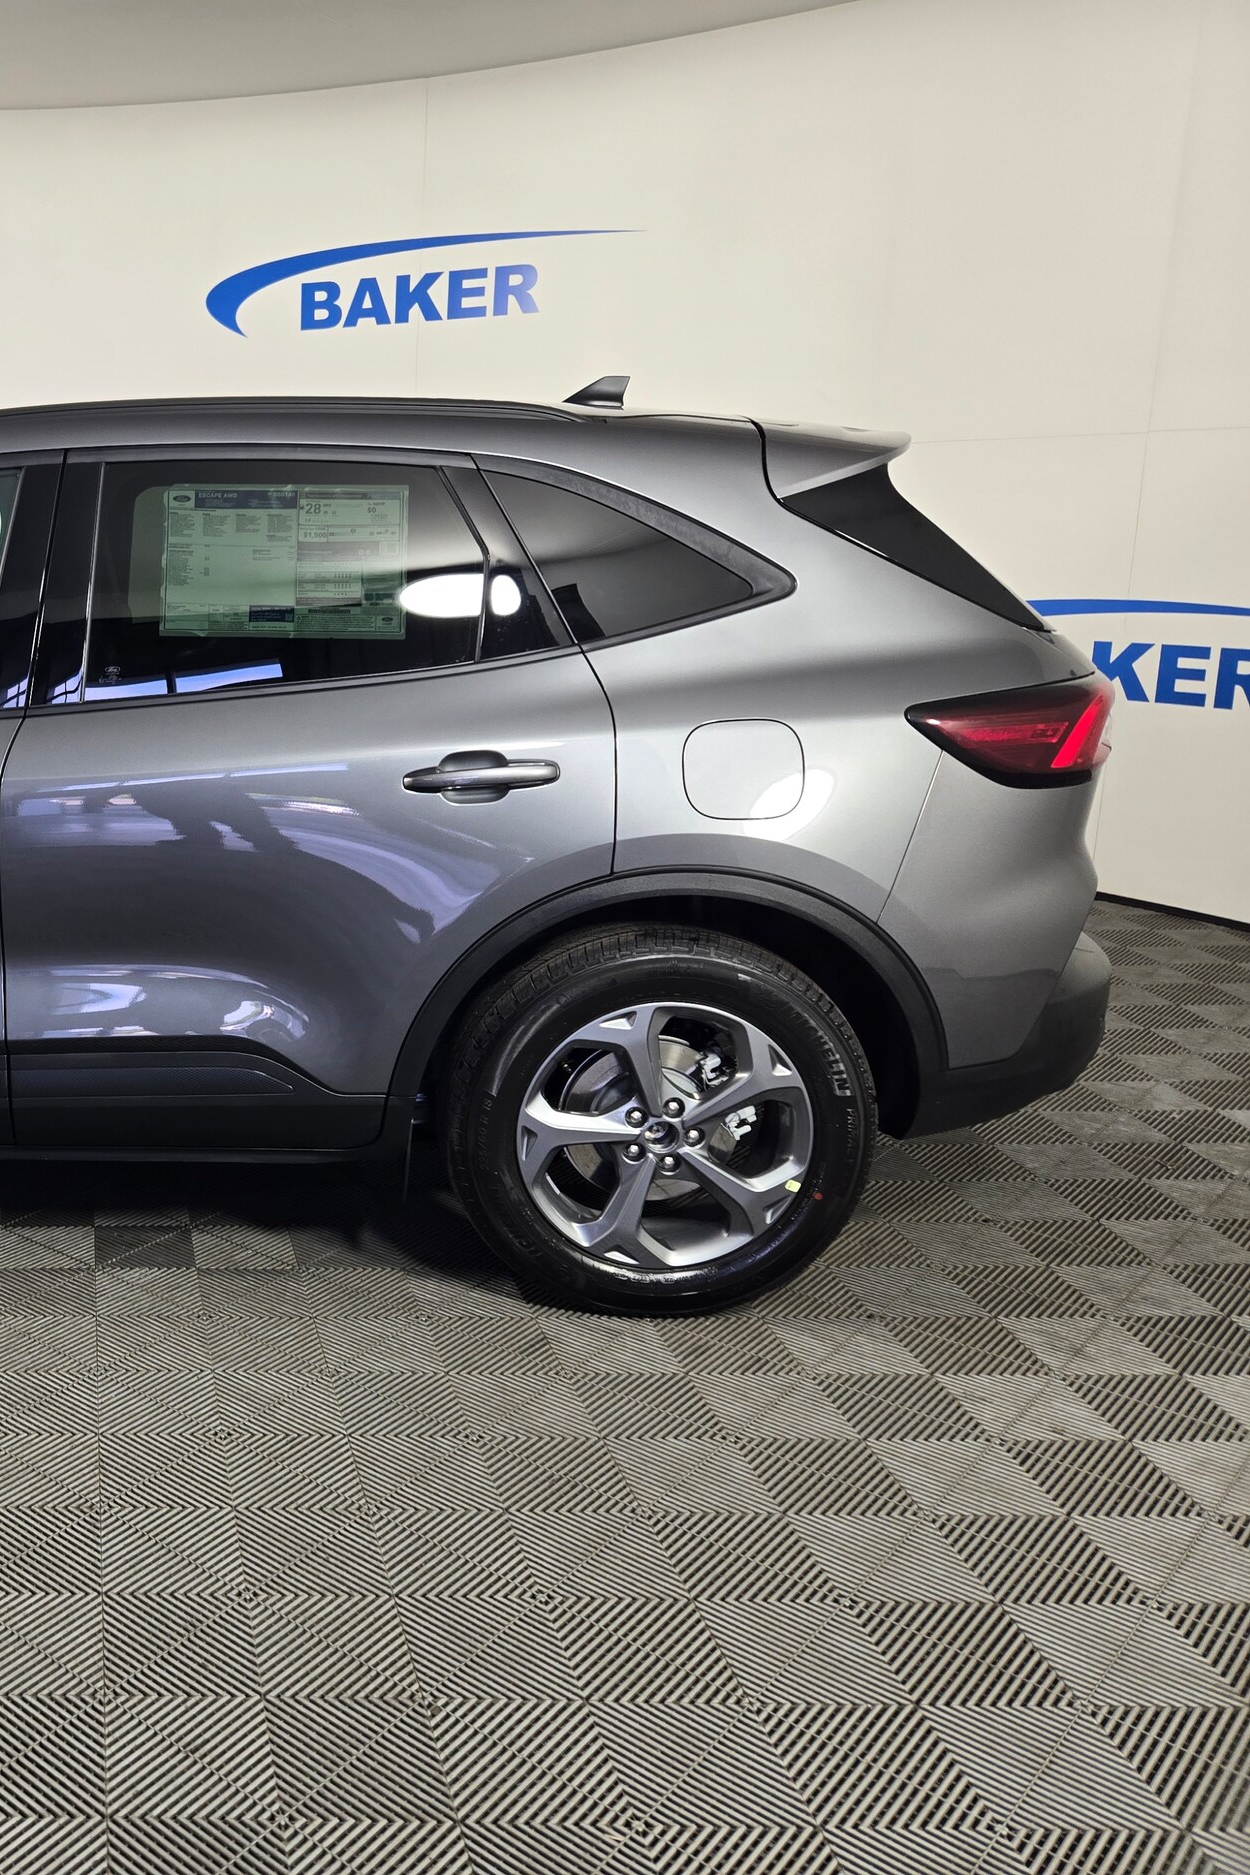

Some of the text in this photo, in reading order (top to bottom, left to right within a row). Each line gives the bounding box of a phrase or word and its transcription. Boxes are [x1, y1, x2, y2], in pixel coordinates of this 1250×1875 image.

[300, 263, 540, 331] BAKER
[305, 503, 321, 514] 28
[1092, 641, 1250, 710] KER
[785, 1002, 851, 1092] MICHELIN
